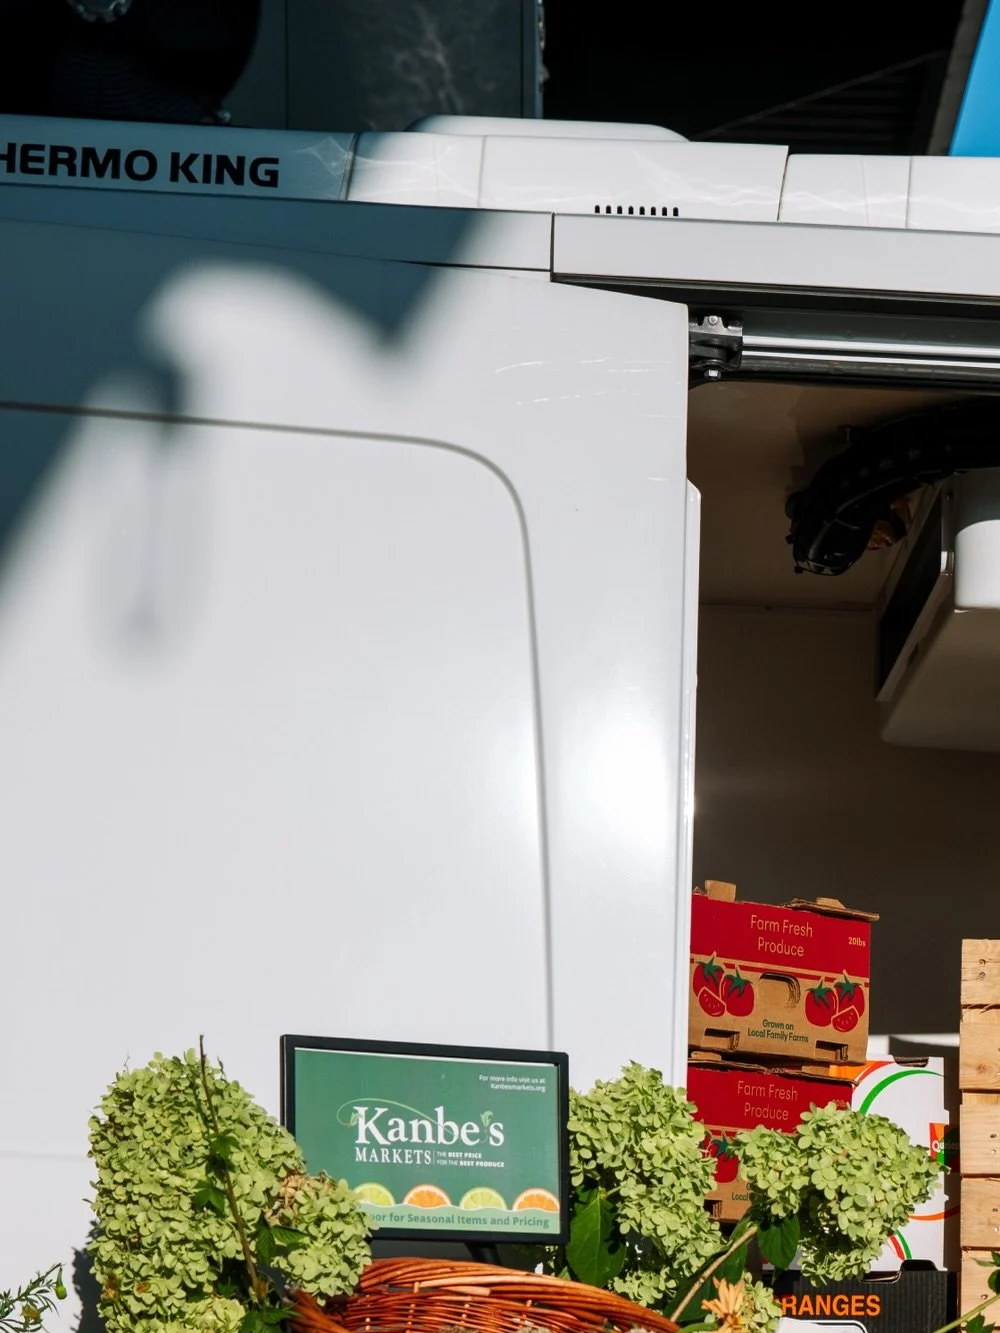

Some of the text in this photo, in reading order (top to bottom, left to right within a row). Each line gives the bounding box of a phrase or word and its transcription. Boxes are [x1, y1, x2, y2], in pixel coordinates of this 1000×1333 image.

[169, 152, 280, 188] KING
[750, 915, 813, 938] Farm Fresh
[757, 937, 805, 957] Produce
[848, 936, 866, 948] 20lbs
[762, 1018, 794, 1030] Grown on
[747, 1026, 809, 1043] Local Family Farms
[506, 1075, 518, 1083] info
[519, 1076, 531, 1084] visit
[737, 1080, 798, 1101] Farm Fresh
[744, 1102, 789, 1121] Produce
[353, 1104, 505, 1147] Kanbe's
[355, 1147, 431, 1165] MARKETS
[390, 1212, 405, 1221] for
[408, 1213, 454, 1224] Seasonal
[457, 1214, 488, 1225] Items
[490, 1215, 509, 1225] and
[512, 1216, 550, 1228] Pricing
[774, 1294, 881, 1317] RANGES
